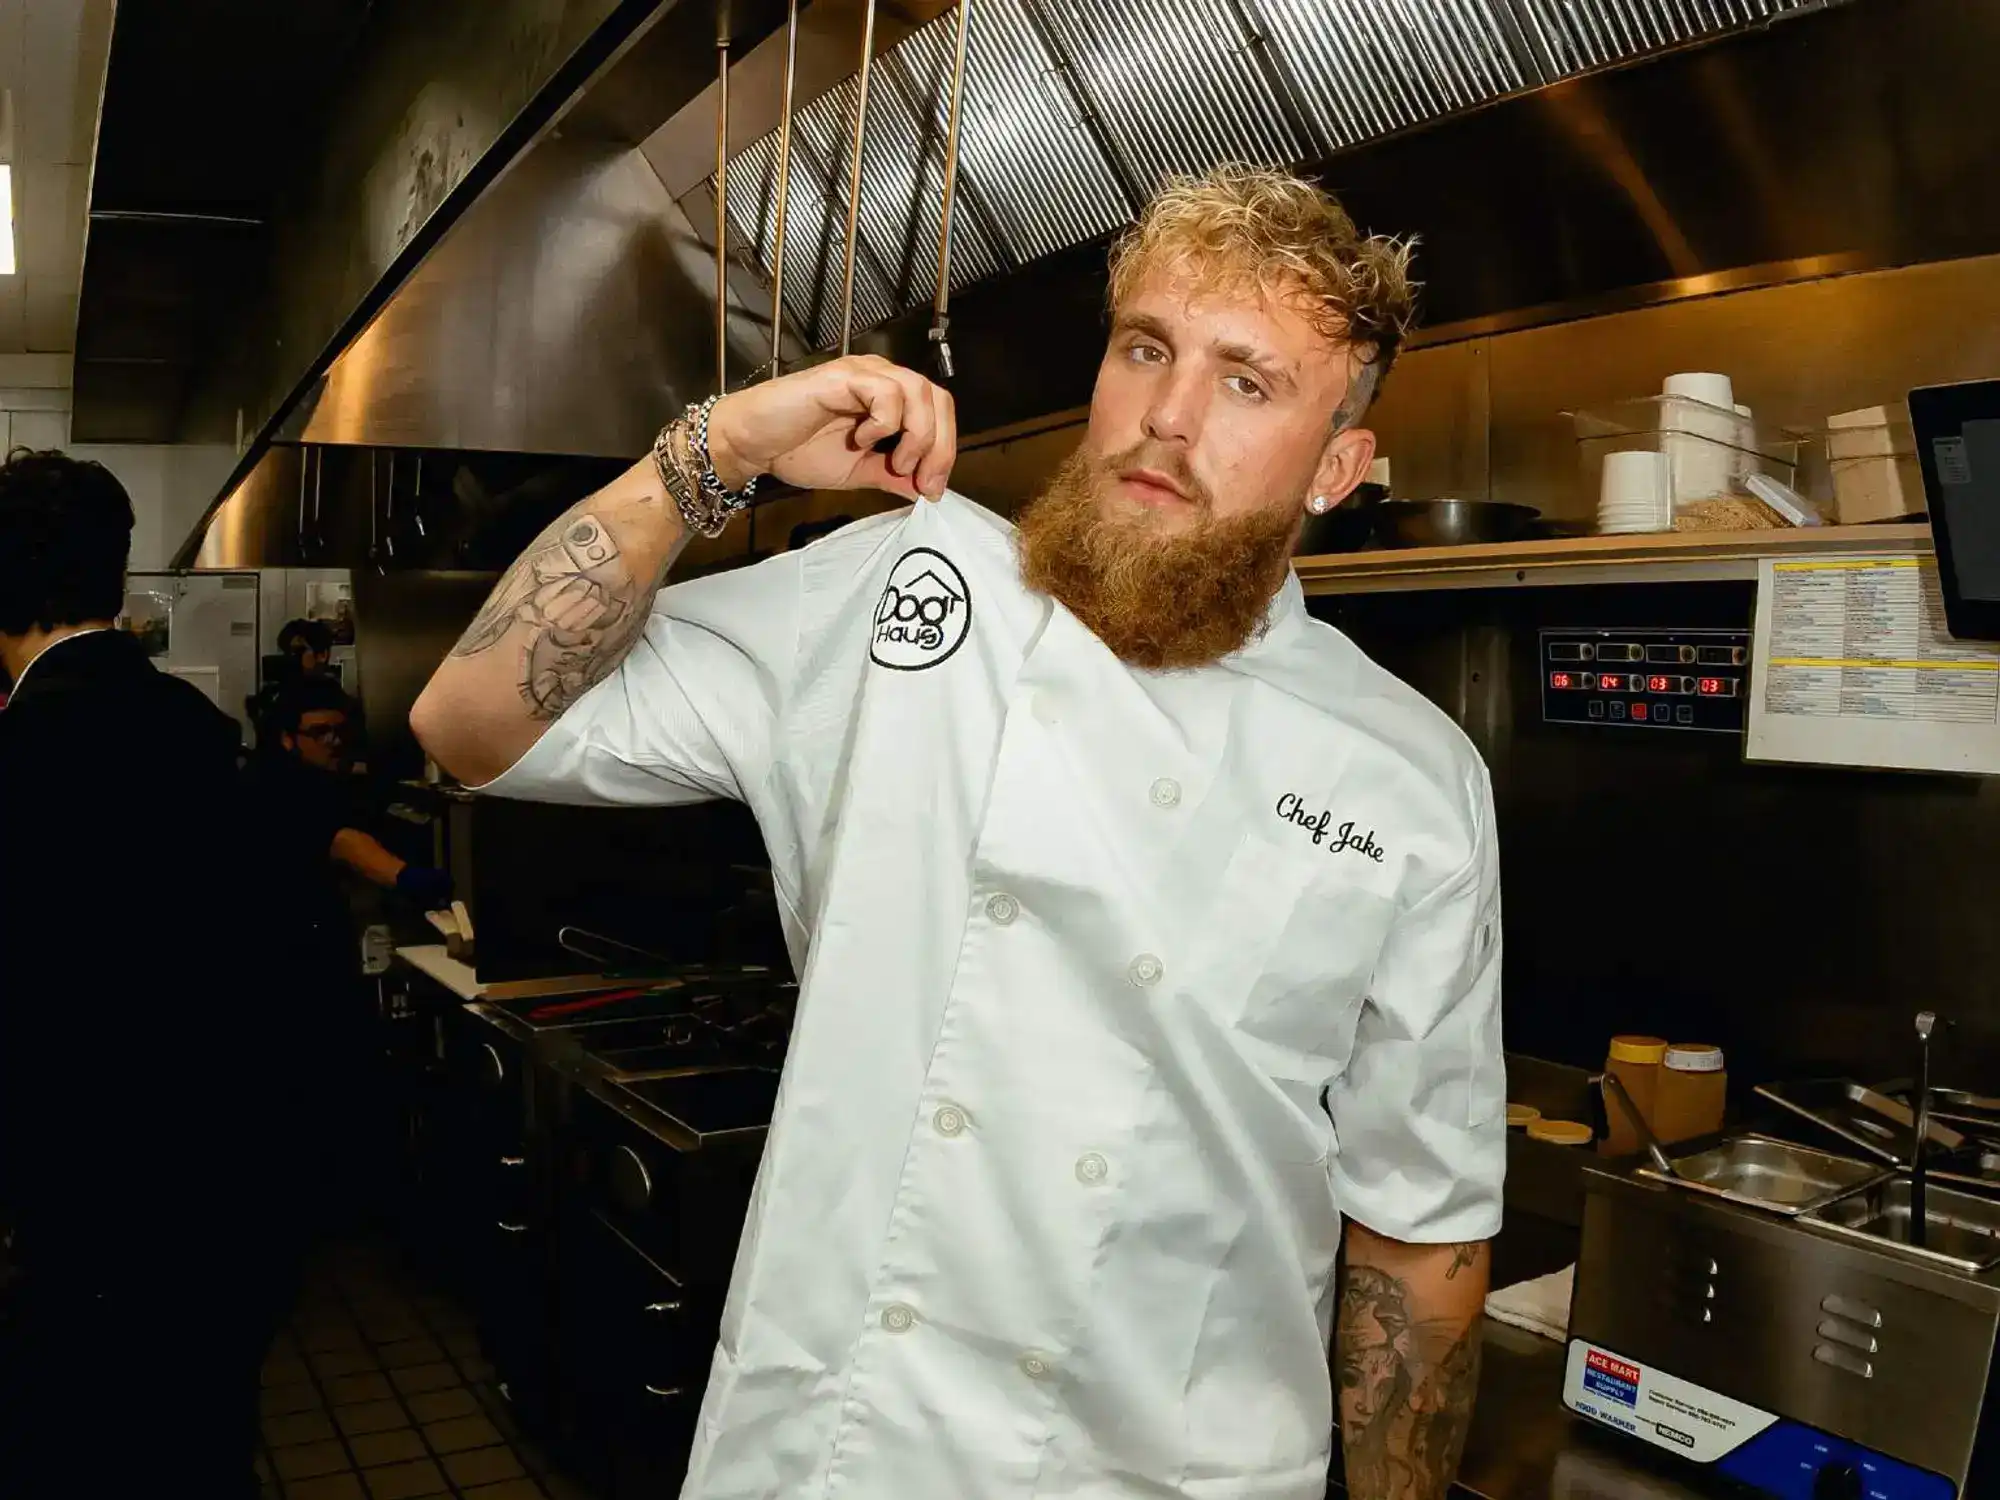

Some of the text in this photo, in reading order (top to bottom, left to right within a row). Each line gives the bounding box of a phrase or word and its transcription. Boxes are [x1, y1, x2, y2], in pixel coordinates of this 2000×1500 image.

[1554, 675, 1568, 687] 06
[1651, 678, 1667, 690] 03
[1701, 680, 1718, 692] 03
[1276, 793, 1384, 863] Chef Jake
[1589, 1354, 1639, 1381] ACE MART
